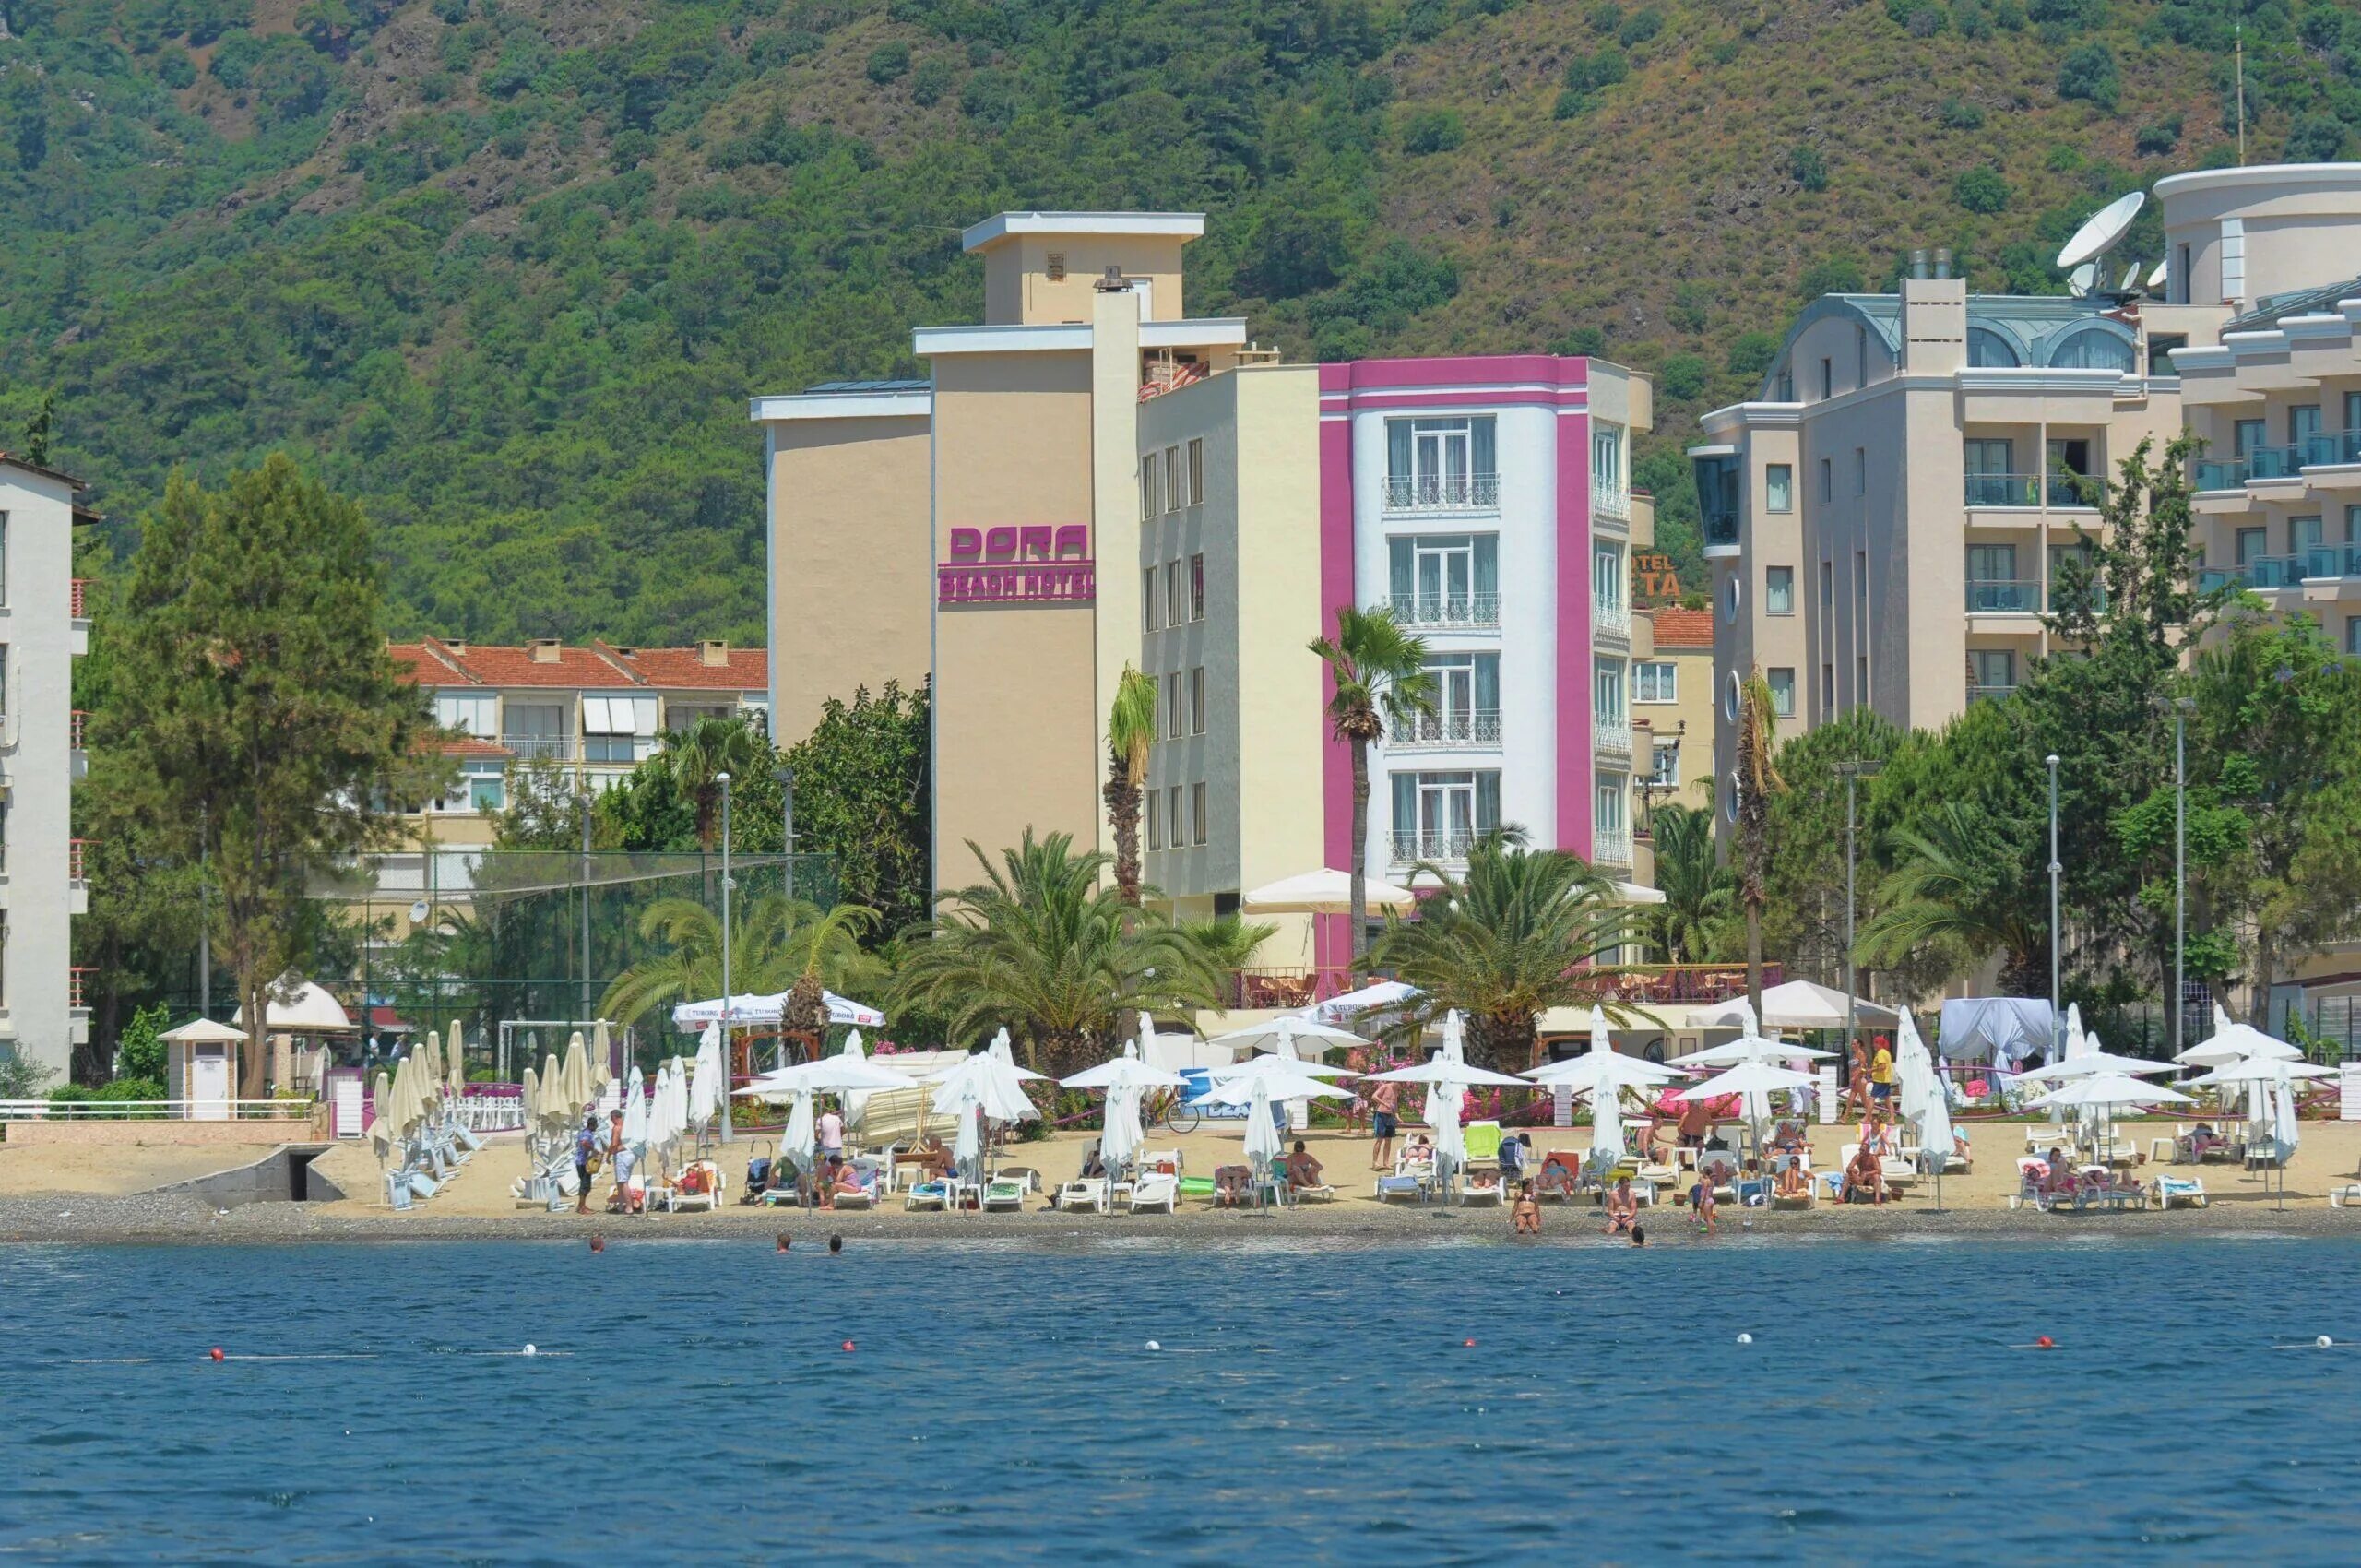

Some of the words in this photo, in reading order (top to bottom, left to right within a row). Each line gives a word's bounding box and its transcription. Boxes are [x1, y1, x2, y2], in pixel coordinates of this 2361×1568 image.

[950, 525, 1087, 553] DORA
[939, 568, 1017, 593] BEACH
[1025, 567, 1095, 592] HOTEL
